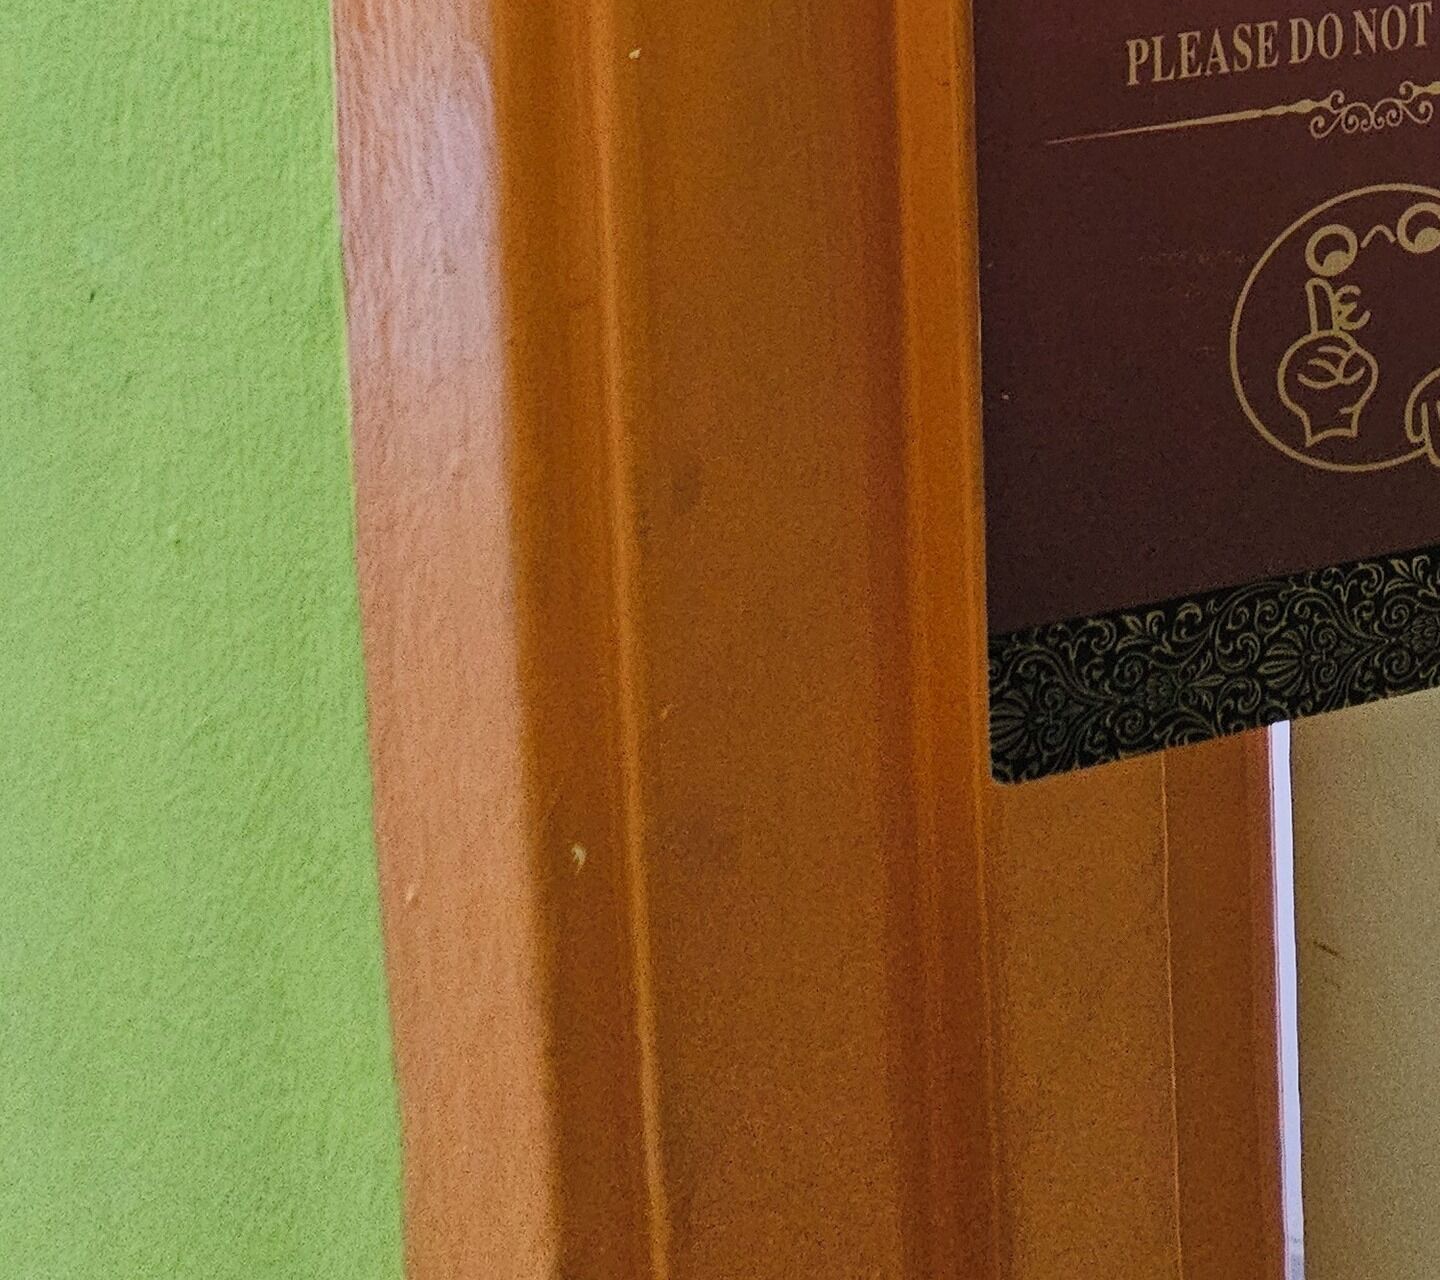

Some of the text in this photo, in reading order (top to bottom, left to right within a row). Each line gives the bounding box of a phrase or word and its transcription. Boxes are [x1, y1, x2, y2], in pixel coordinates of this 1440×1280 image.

[1126, 20, 1279, 86] PLEASE
[1289, 11, 1343, 66] DO
[1352, 1, 1433, 57] NOT
